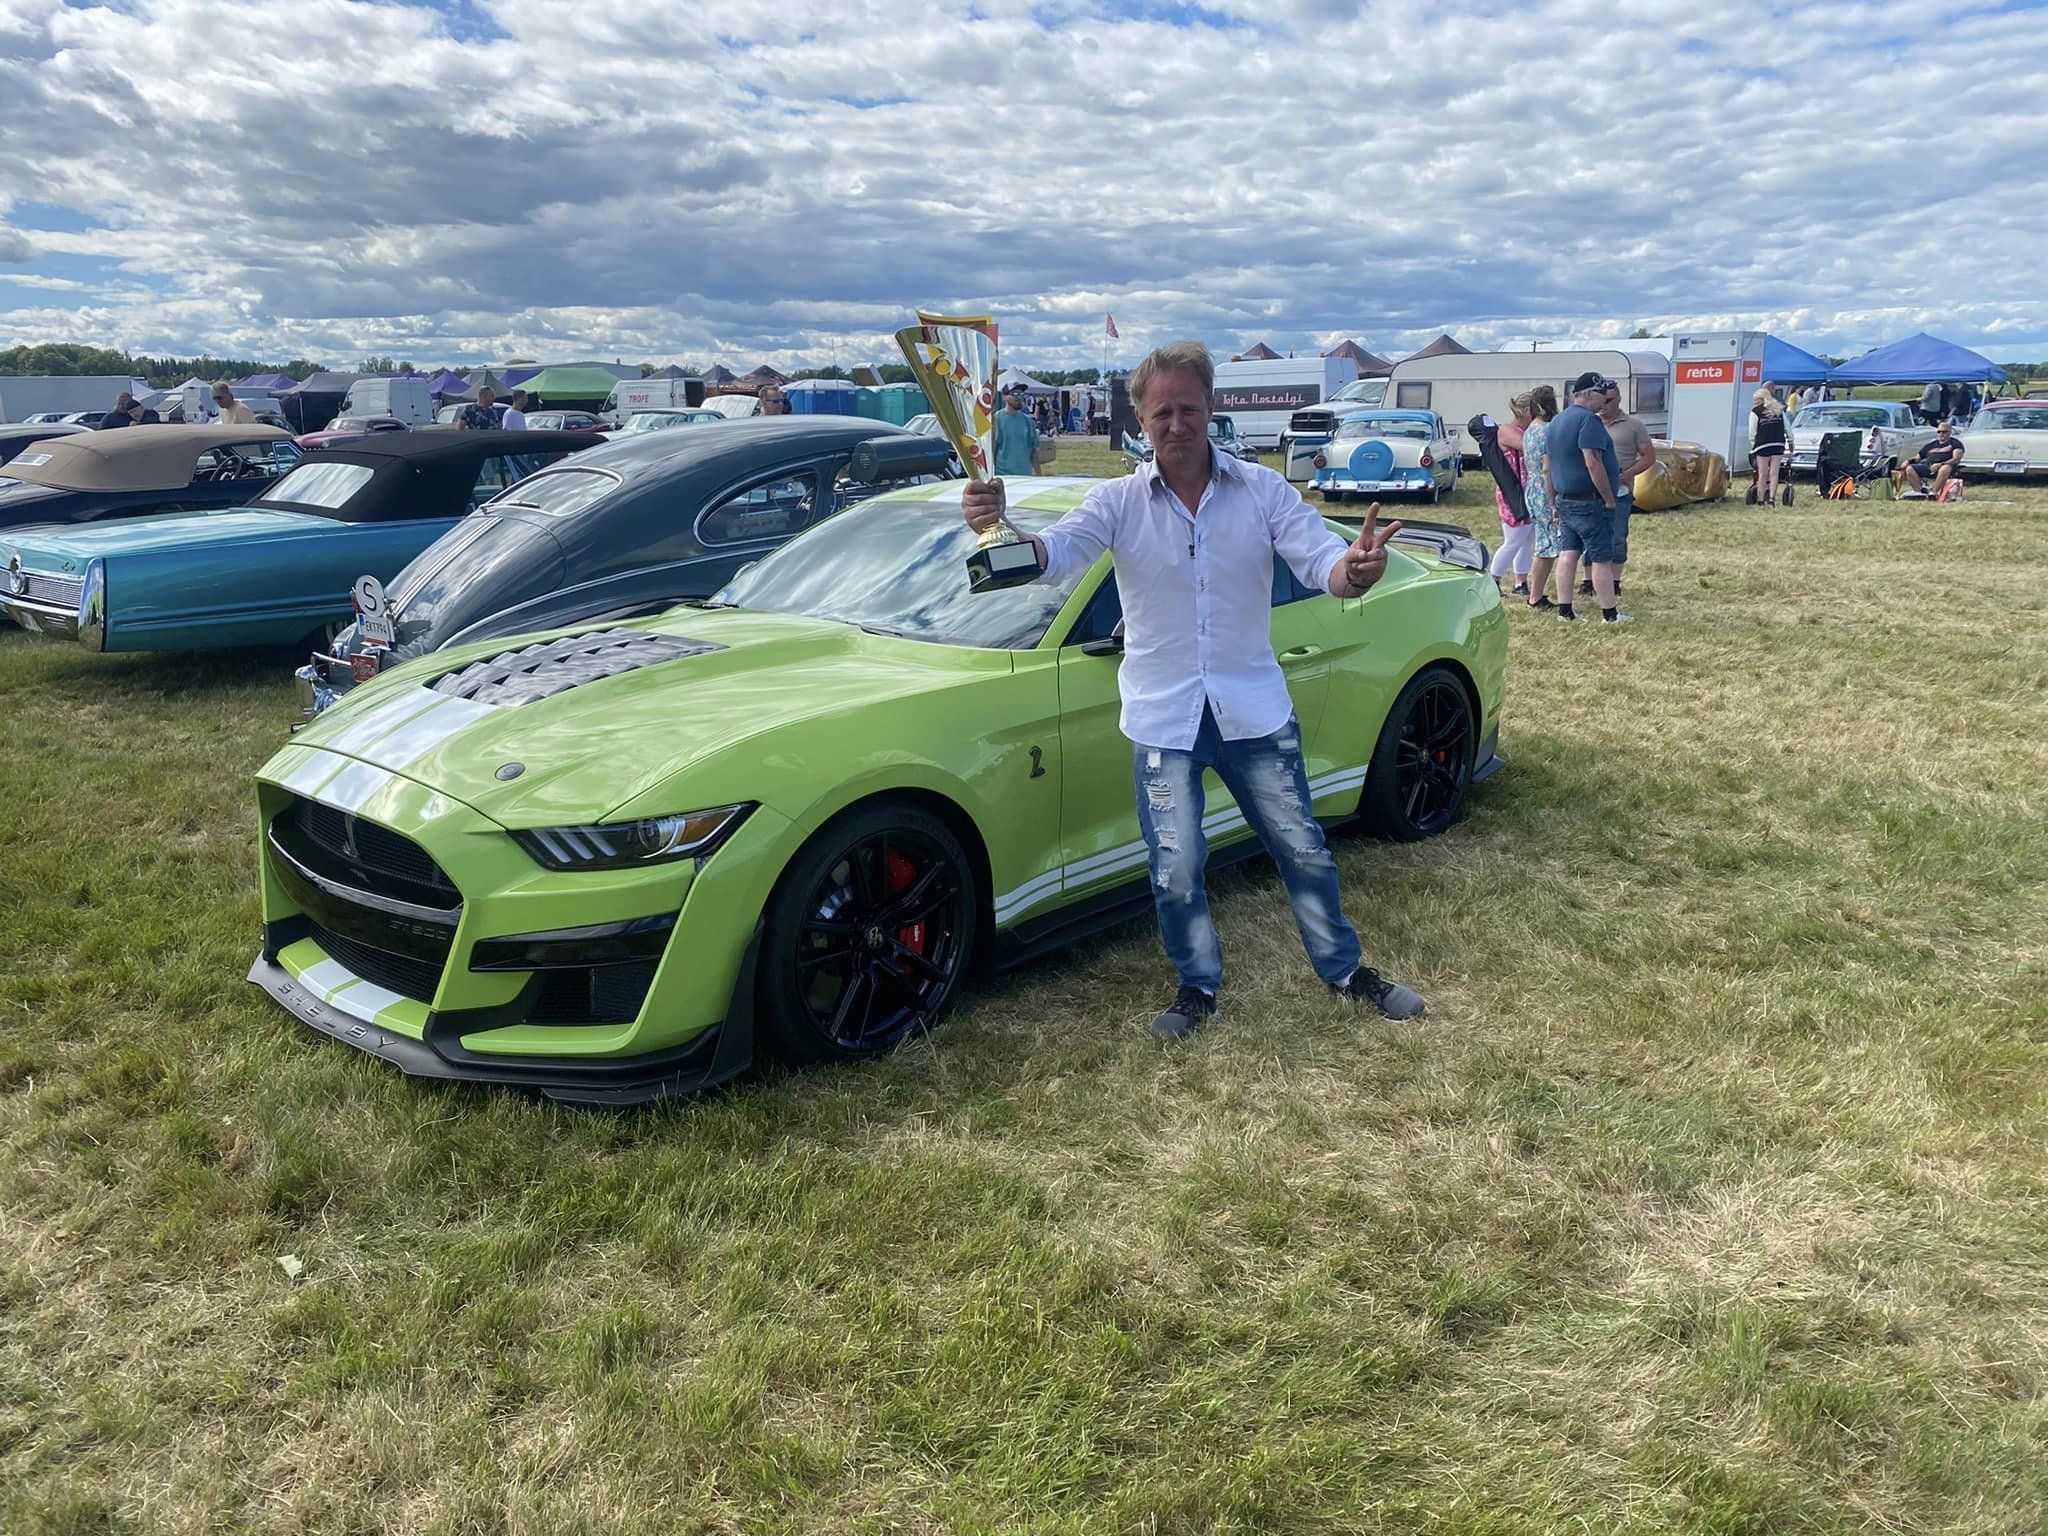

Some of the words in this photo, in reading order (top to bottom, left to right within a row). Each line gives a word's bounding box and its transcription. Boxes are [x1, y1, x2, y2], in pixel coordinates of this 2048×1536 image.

[1686, 366, 1723, 378] renta
[1252, 392, 1304, 406] Nostalgi
[362, 581, 377, 612] S
[277, 983, 397, 1049] SHELBY
